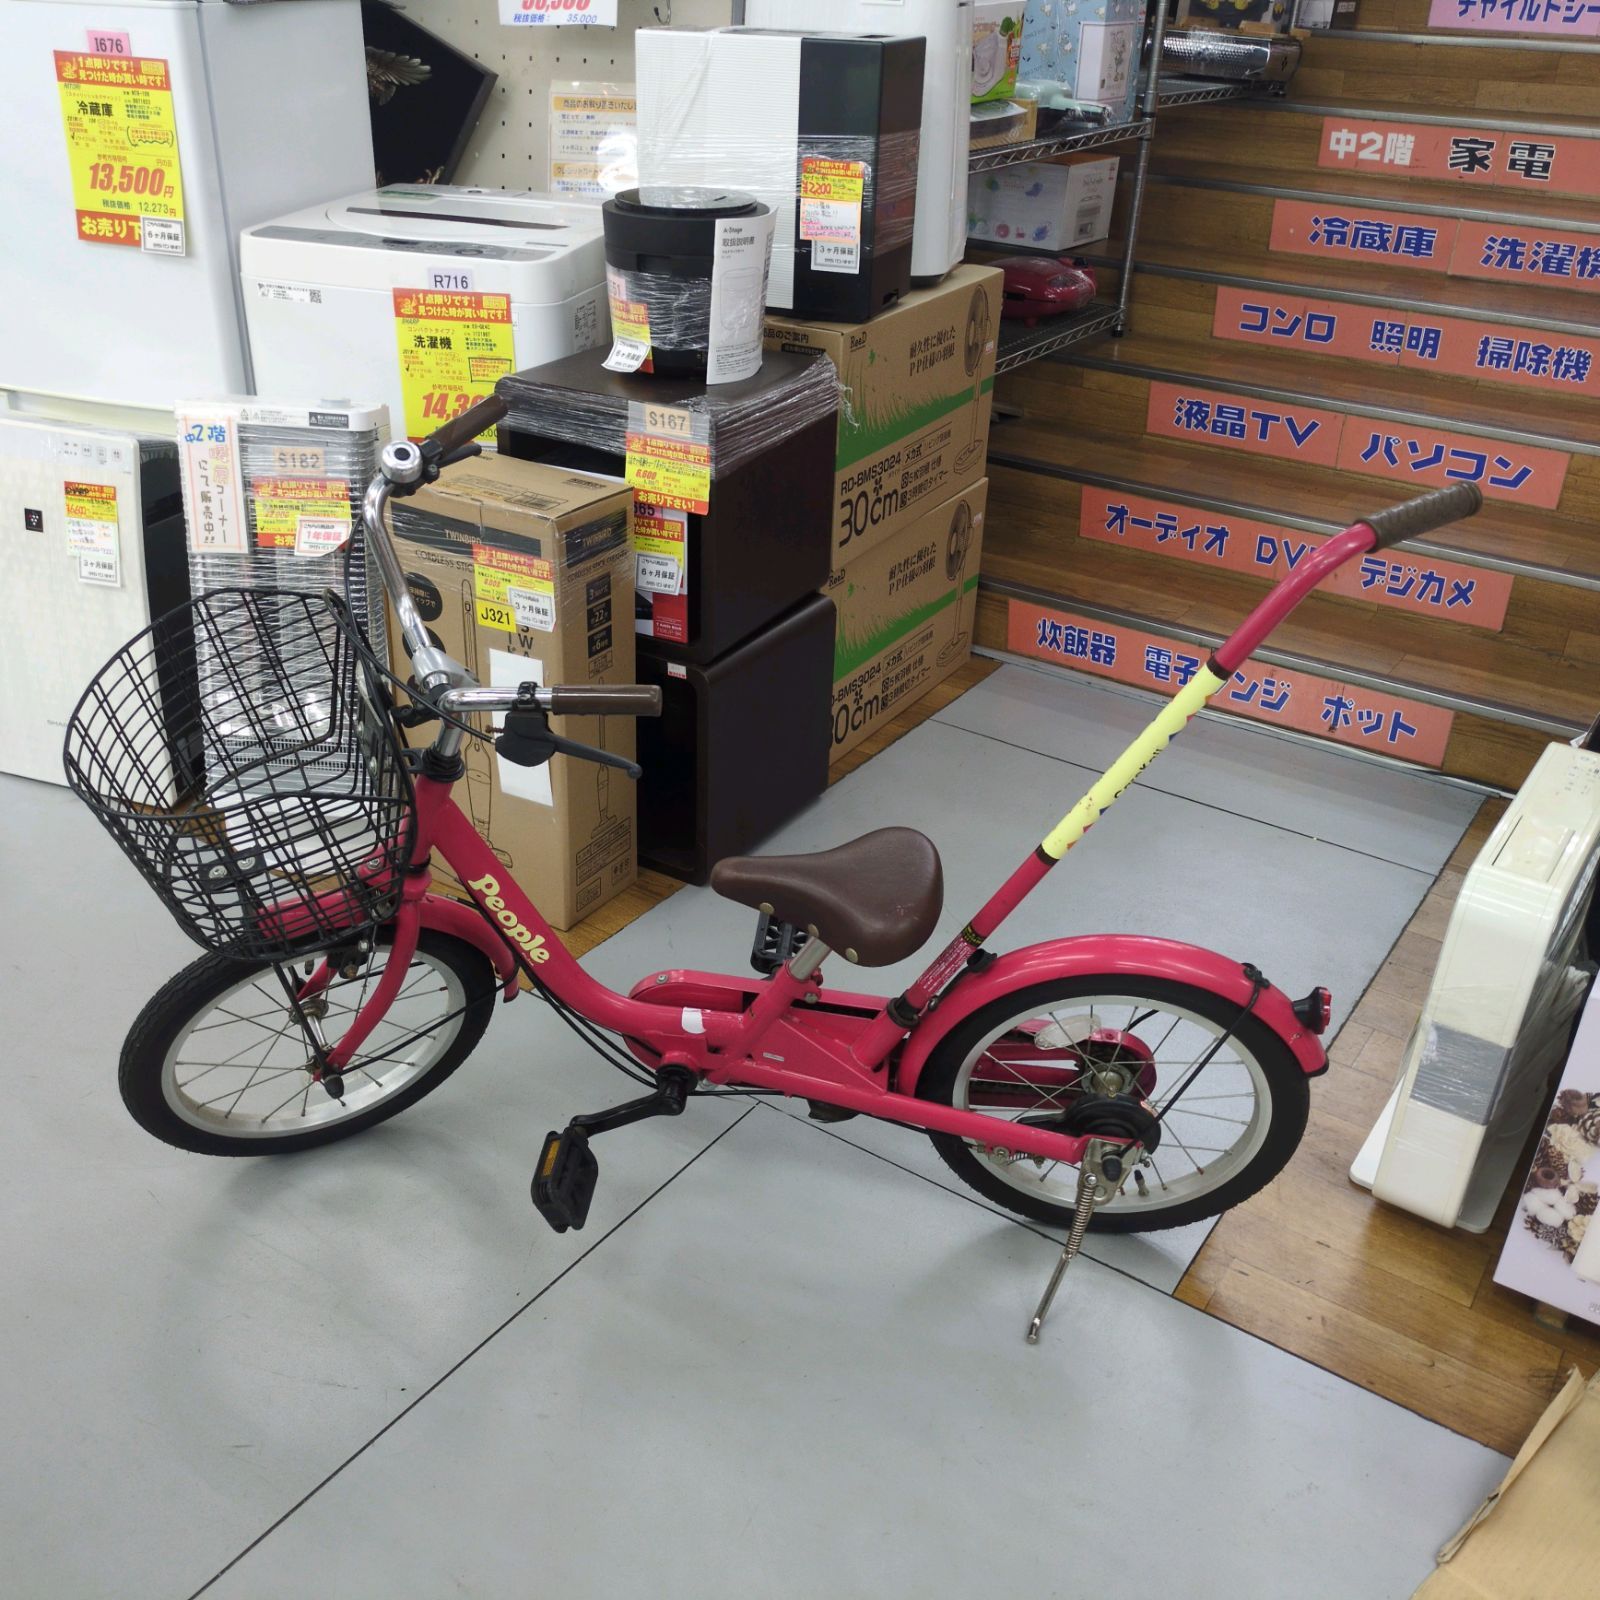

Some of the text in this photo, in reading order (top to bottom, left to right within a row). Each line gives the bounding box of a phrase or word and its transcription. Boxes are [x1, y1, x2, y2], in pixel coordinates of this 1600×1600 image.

[77, 100, 114, 117] 冷蔵庫
[563, 99, 637, 110] 商品のお取り置きいたし
[1329, 129, 1415, 166] 中2階
[1308, 216, 1437, 258] 冷蔵庫
[433, 275, 469, 289] R716
[413, 334, 453, 351] 洗濯機
[1239, 303, 1592, 383] コンロ 照明 掃除機
[649, 411, 686, 431] S167
[185, 424, 226, 443] 中2階
[1174, 396, 1533, 490] 液晶TV パソコン
[278, 452, 320, 469] S182
[840, 451, 902, 496] RD-BMS3024
[638, 491, 695, 512] お売り下さい!
[838, 488, 899, 548] 30cm
[306, 530, 342, 542] 1年保証
[1105, 504, 1230, 557] オーディオ
[1360, 556, 1476, 607] デジカメ
[641, 567, 675, 580] 6ヶ月保証
[481, 607, 511, 626] J321
[1037, 617, 1117, 667] 炊飯器
[1320, 693, 1417, 744] ポット
[467, 873, 550, 964] People
